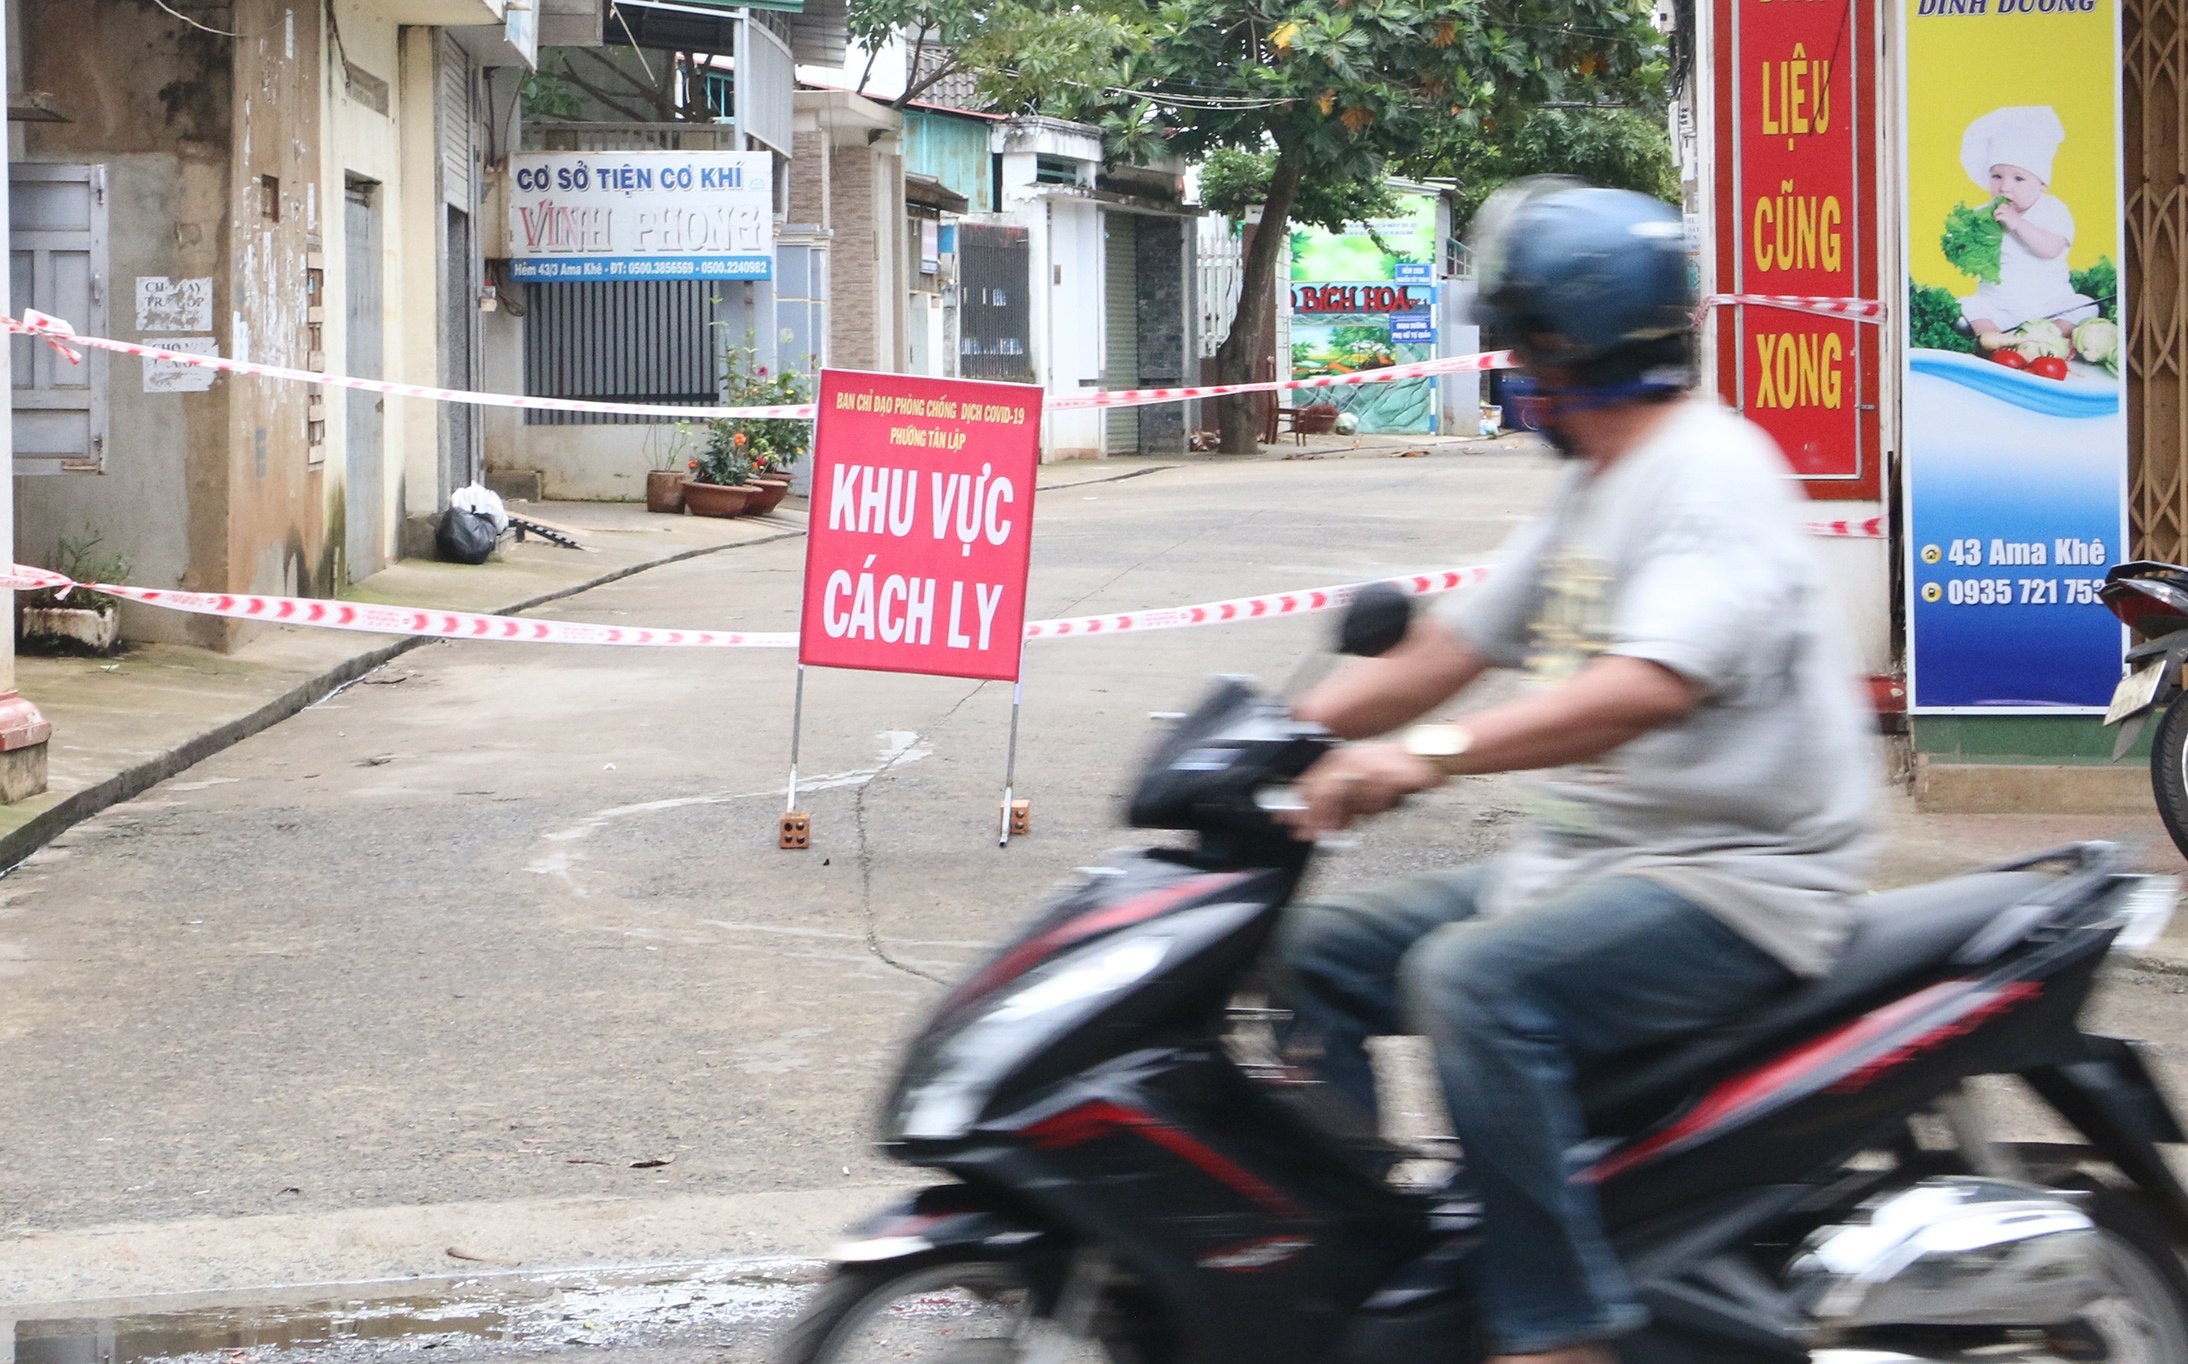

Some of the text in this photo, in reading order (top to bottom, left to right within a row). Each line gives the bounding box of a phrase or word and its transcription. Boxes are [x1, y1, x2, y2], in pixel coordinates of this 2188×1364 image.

[1762, 42, 1831, 151] LIỆU
[517, 160, 745, 195] CƠ SỞ TIỆN CƠ KHÍ
[1753, 179, 1841, 272] CŨNG
[560, 263, 582, 276] Ama
[1360, 286, 1412, 313] HOA
[1756, 333, 1842, 410] XONG
[836, 389, 1025, 425] BAN CHỈ ĐẠO PHÒNG CHỐNG DỊCH COVID-19
[890, 424, 967, 453] PHƯỜNG TÂN LẬP
[828, 462, 1014, 557] KHU VỰC
[1948, 538, 2106, 565] 43 Ama Khê
[823, 554, 1004, 651] CÁCH LY
[1948, 579, 2013, 605] 0935
[2018, 578, 2058, 604] 721
